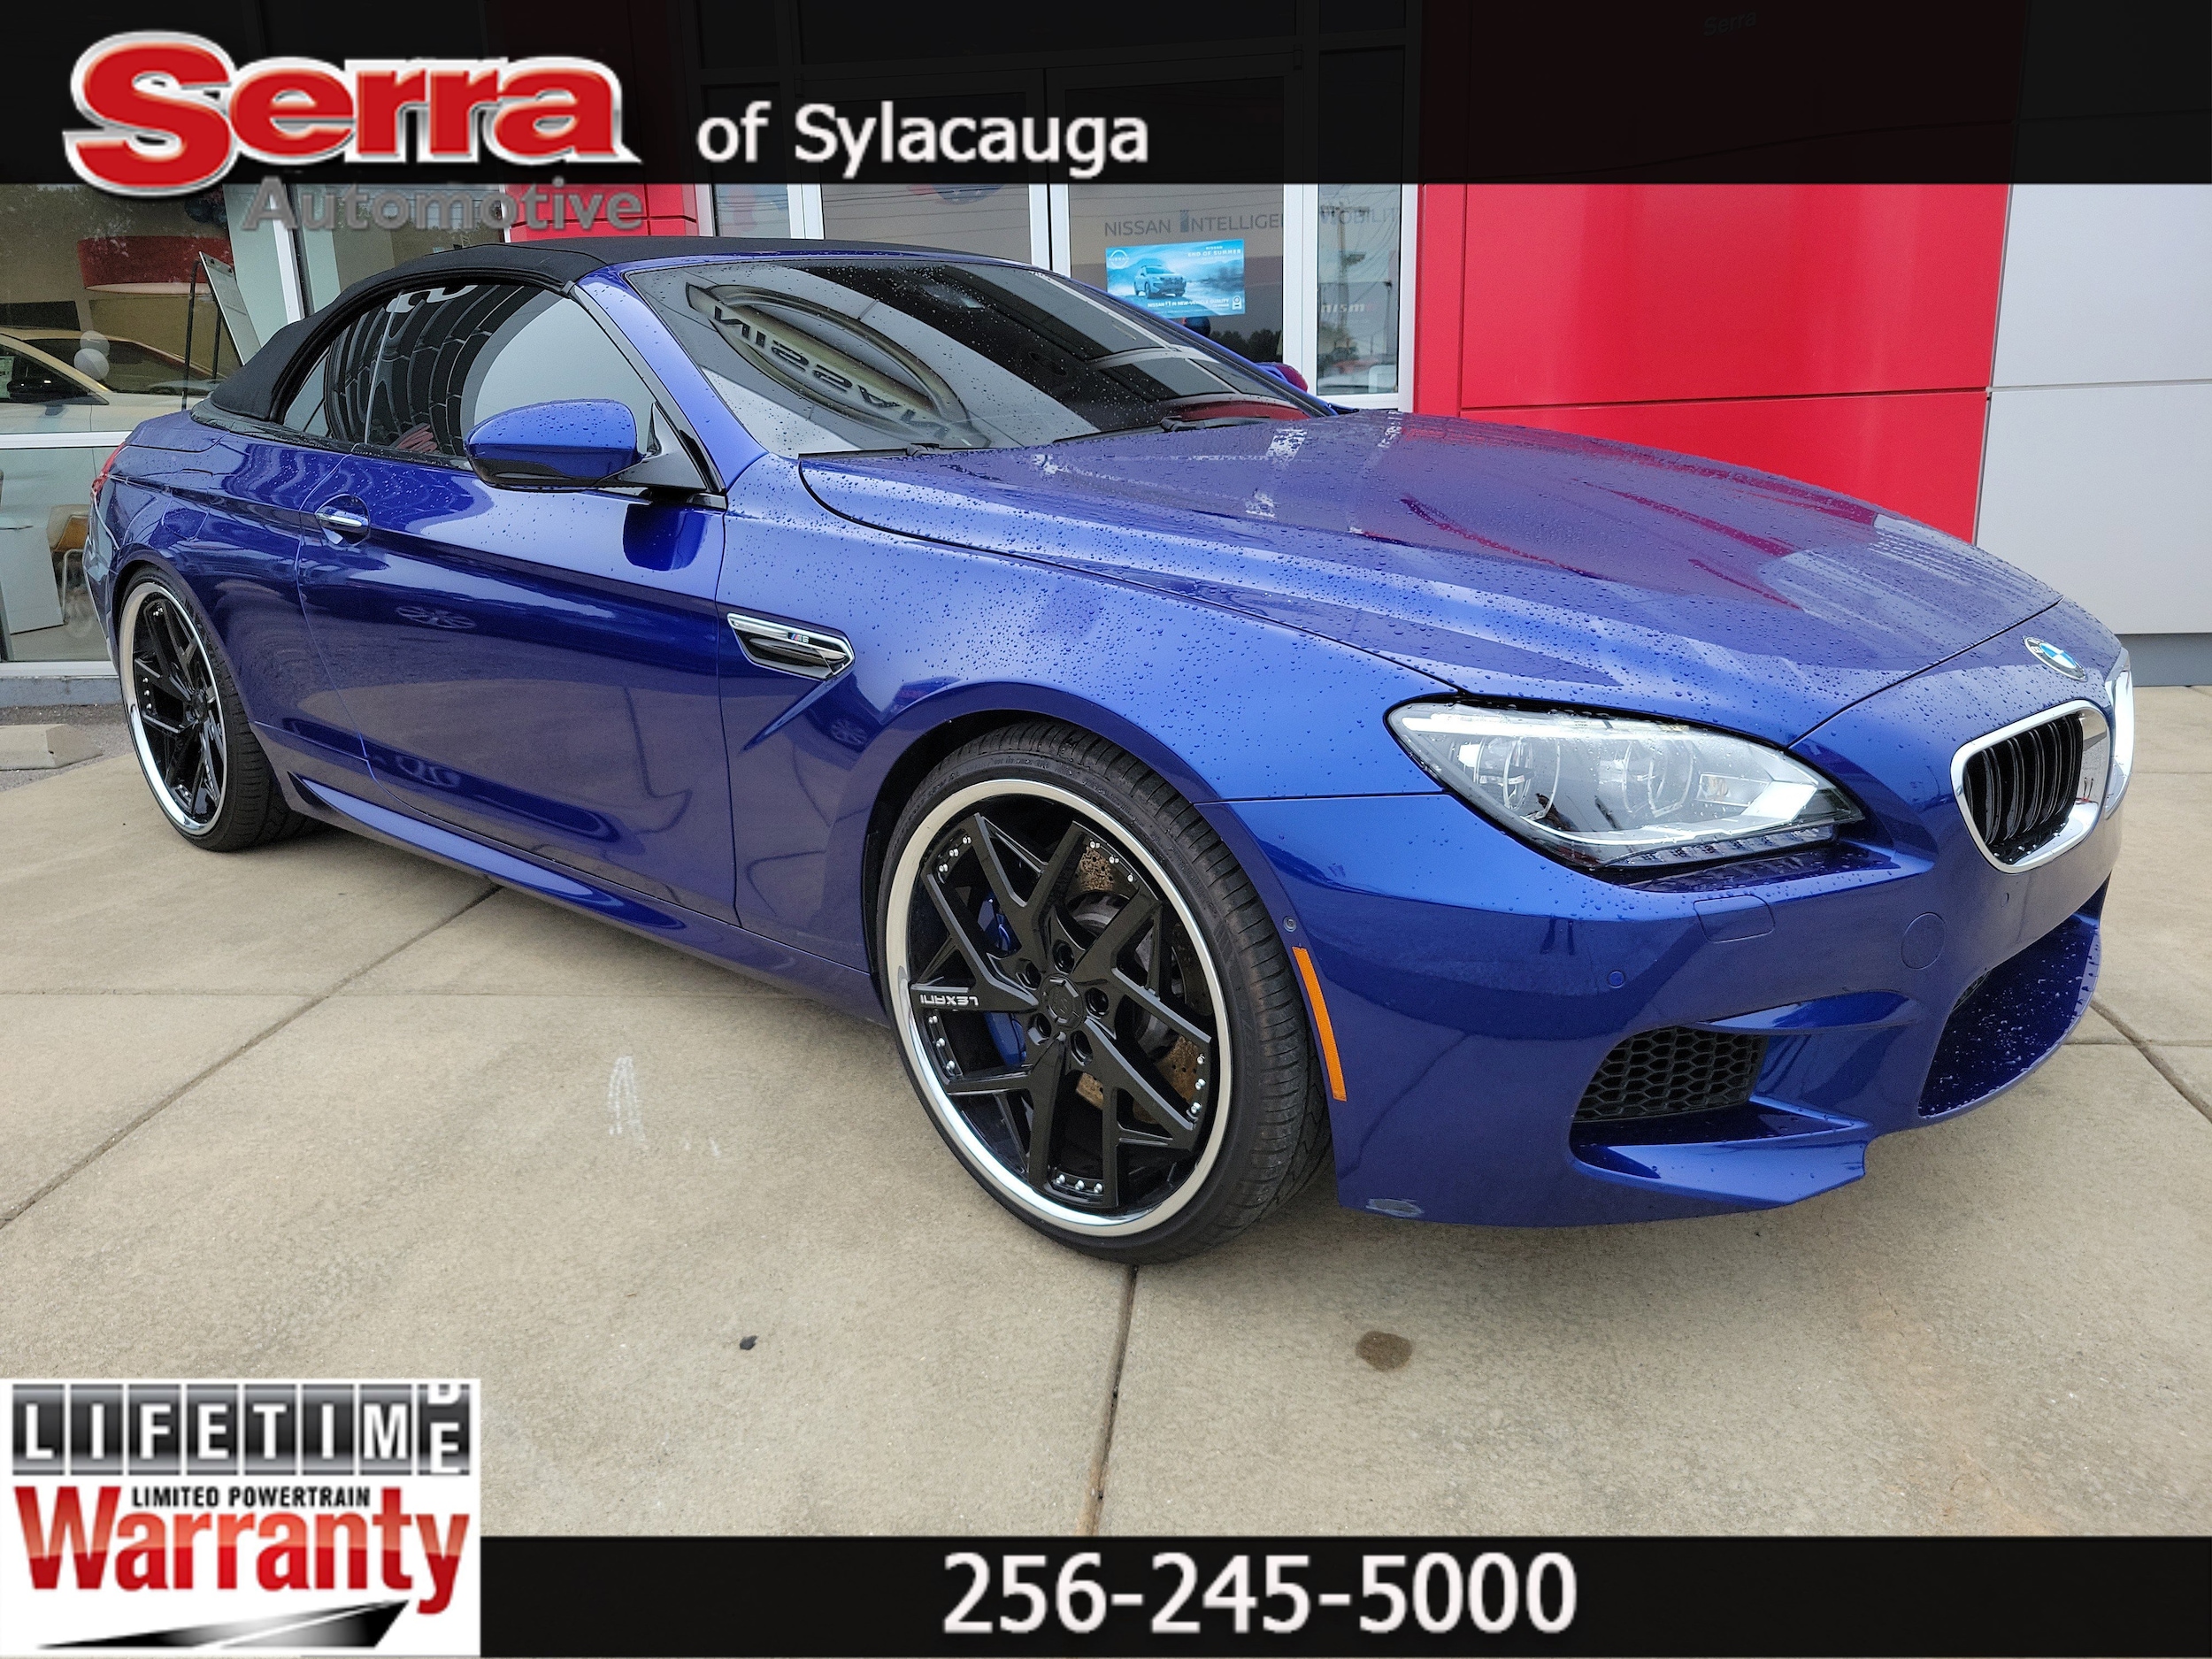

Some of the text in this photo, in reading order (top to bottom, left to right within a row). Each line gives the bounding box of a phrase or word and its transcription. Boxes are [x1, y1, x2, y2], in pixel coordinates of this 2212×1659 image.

[1104, 219, 1171, 237] NISSAN
[1179, 210, 1283, 233] INTELLIGE
[920, 994, 979, 1006] LEXANI
